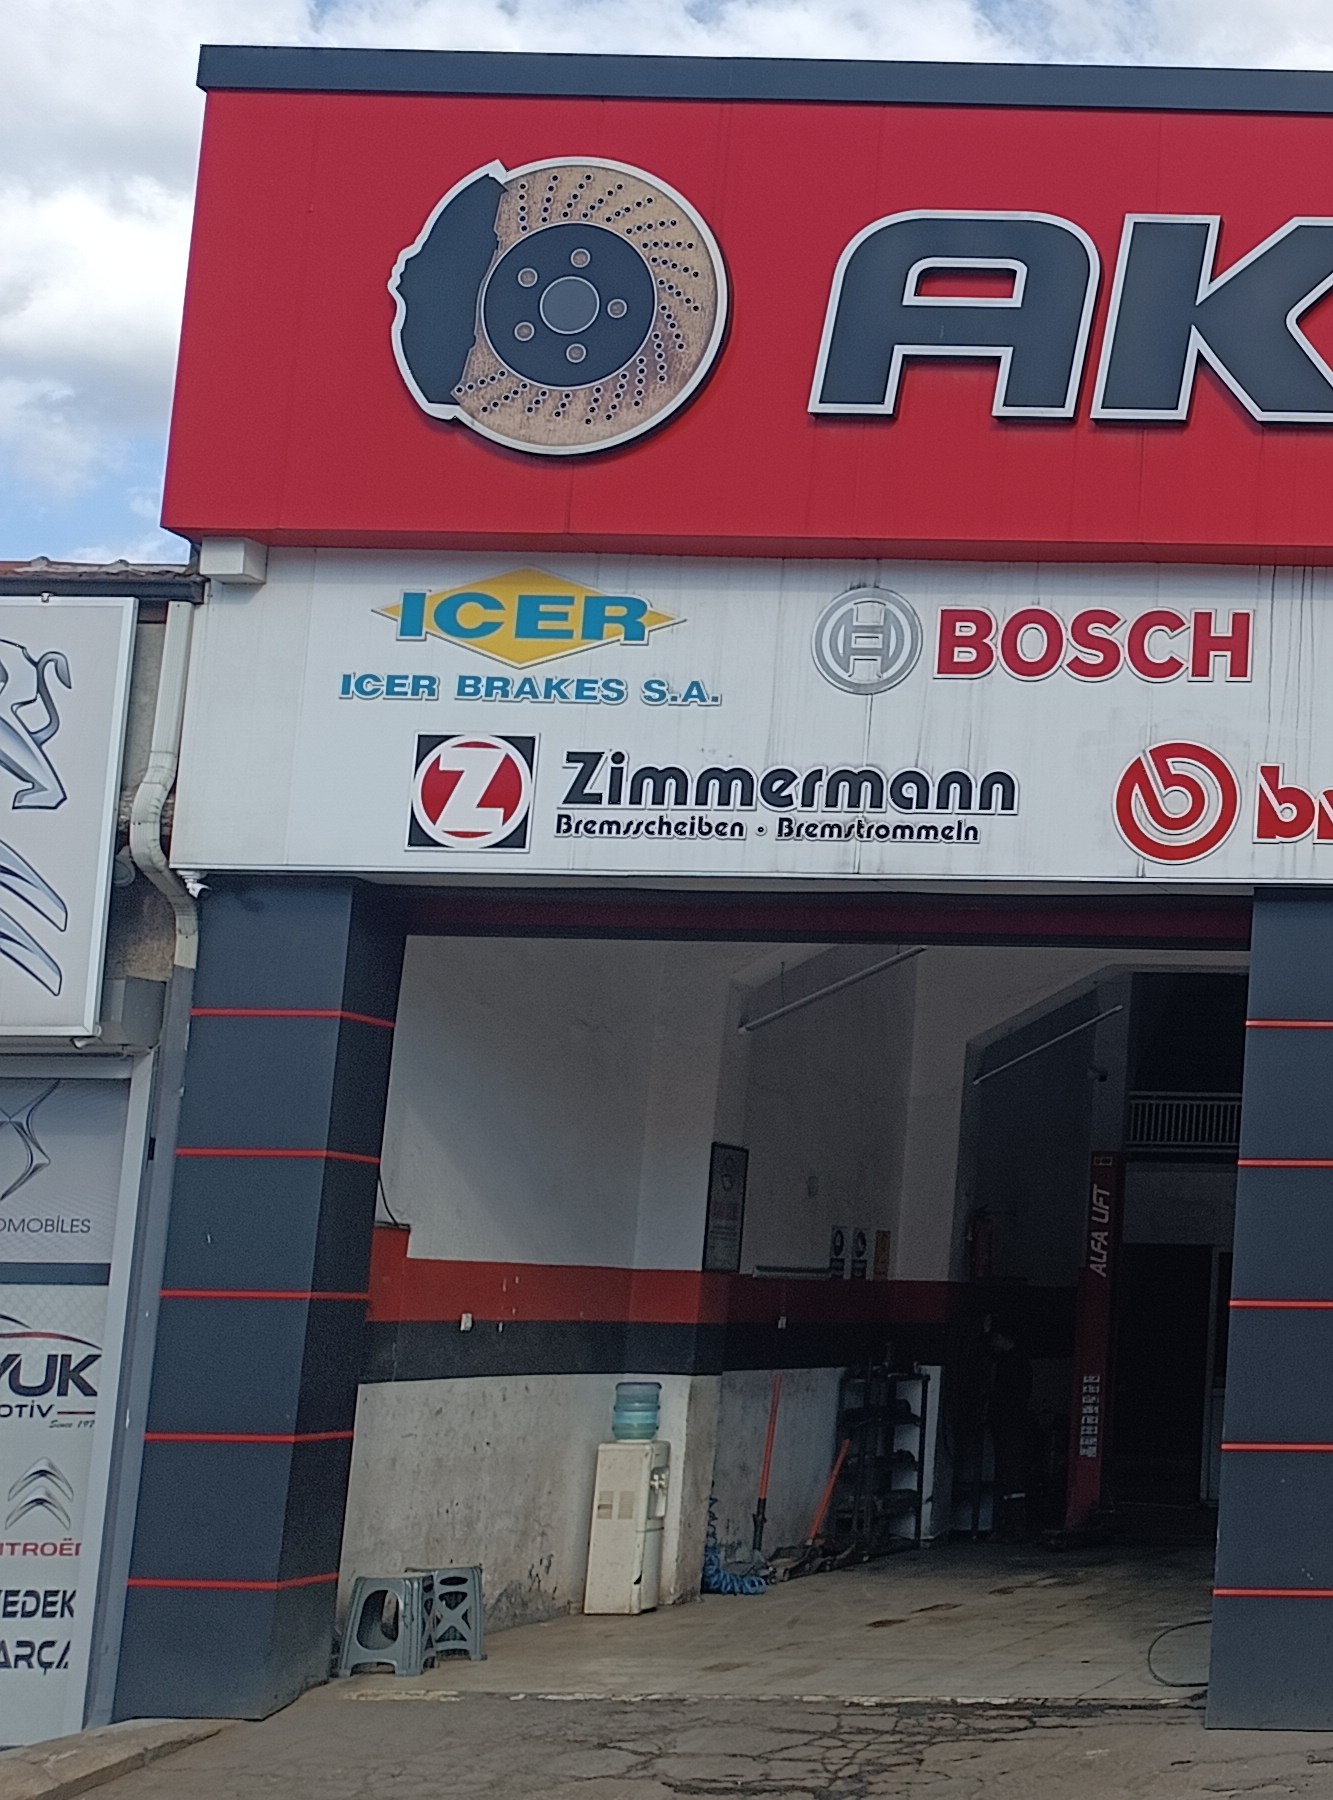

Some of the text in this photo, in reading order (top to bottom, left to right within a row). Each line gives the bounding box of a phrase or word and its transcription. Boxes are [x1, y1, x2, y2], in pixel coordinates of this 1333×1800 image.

[398, 591, 650, 643] ICER
[936, 608, 1253, 682] BOSCH
[341, 673, 723, 707] ICER BRAKES S.A.
[563, 750, 1017, 812] Zimmermann
[556, 815, 979, 842] Bremsscheiben Bremstrommeln
[1091, 1183, 1110, 1224] LIFT
[0, 1214, 91, 1235] MOBİLES
[1090, 1231, 1109, 1279] ALFA
[0, 1589, 76, 1618] EDEK
